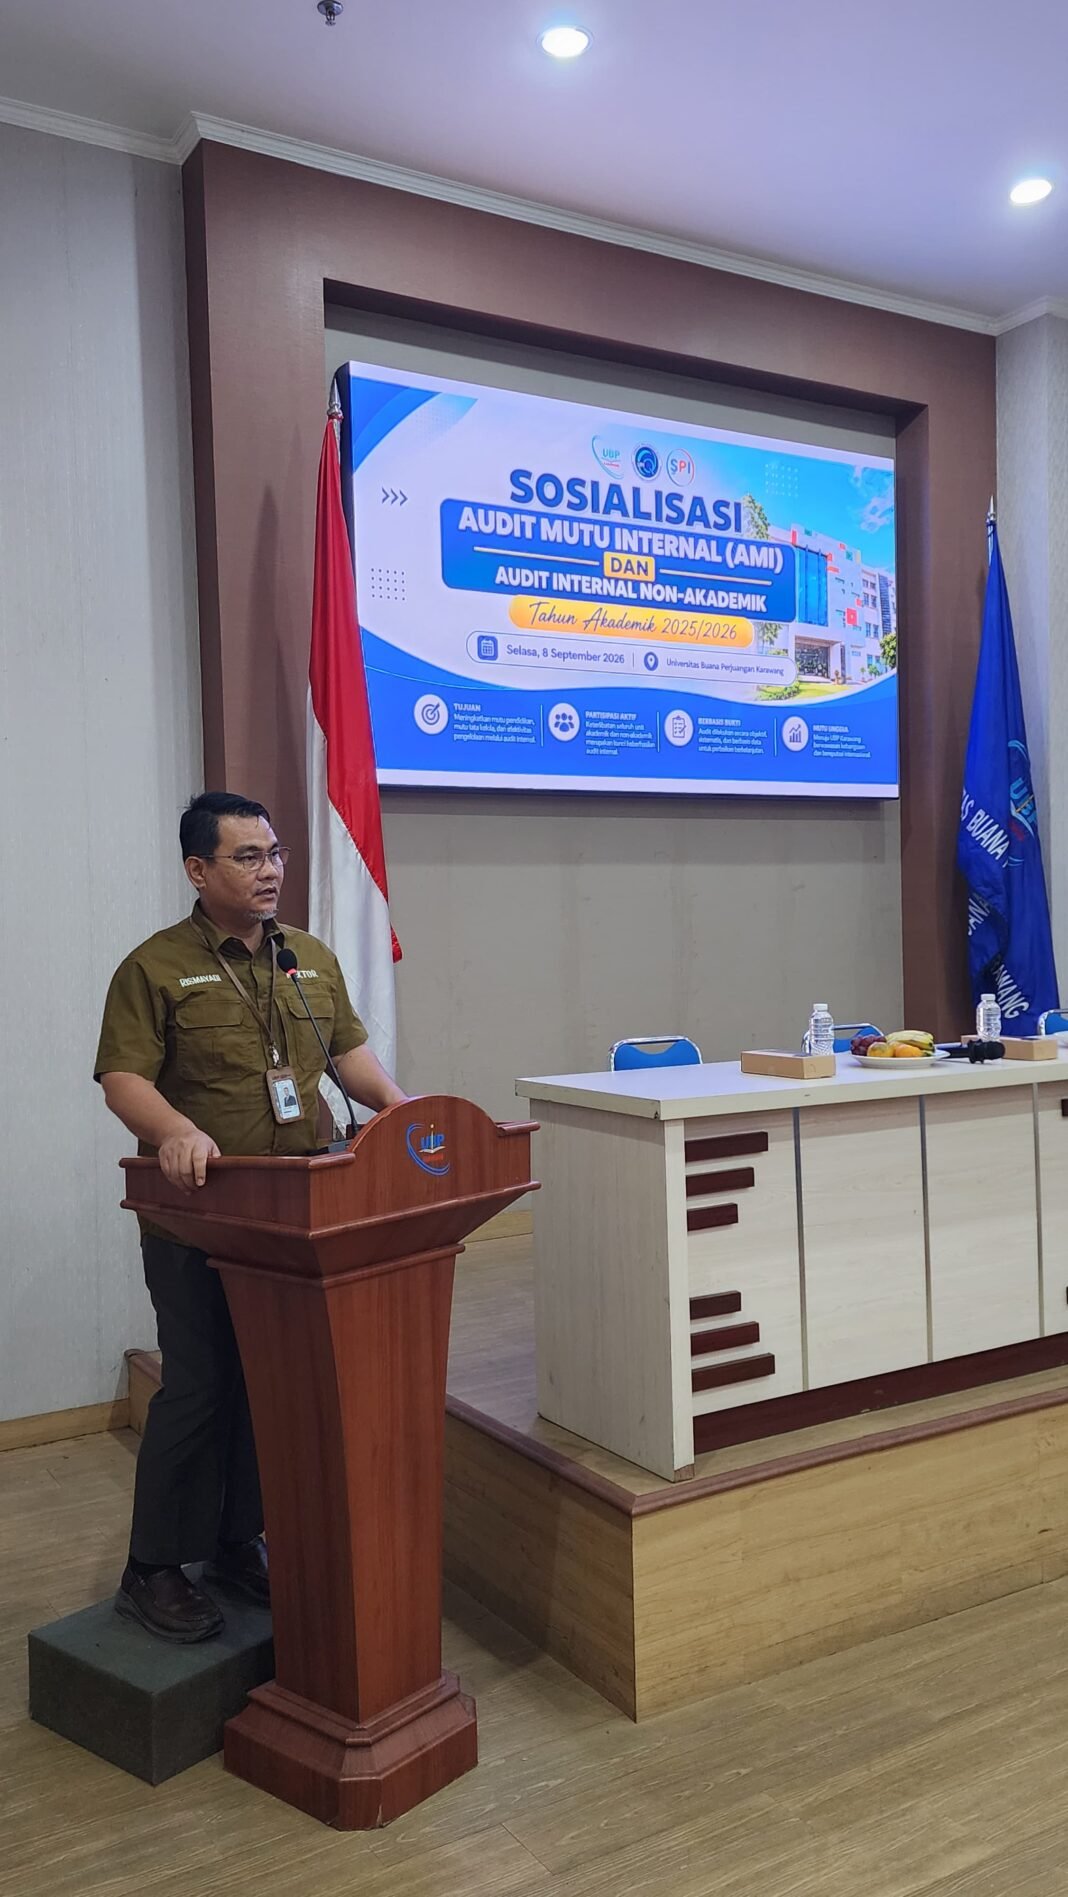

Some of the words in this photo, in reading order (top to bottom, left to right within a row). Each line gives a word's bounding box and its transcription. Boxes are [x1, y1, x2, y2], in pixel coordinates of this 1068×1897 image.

[670, 459, 691, 474] SPI
[510, 469, 742, 533] SOSIALISASI
[458, 507, 537, 539] AUDIT
[540, 518, 611, 549] MUTU
[614, 528, 722, 563] INTERNAL
[726, 542, 784, 574] (AMI)
[610, 557, 649, 576] DAN
[495, 566, 550, 589] AUDIT
[552, 572, 638, 599] INTERNAL
[640, 584, 767, 612] NON-AKADEMIK
[529, 602, 578, 626] Tahun
[582, 607, 658, 633] Akademik
[661, 618, 737, 640] 2025/2026
[506, 644, 540, 658] Selasa,
[542, 648, 549, 657] 8
[551, 648, 602, 662] September
[603, 652, 625, 664] 2026
[666, 657, 700, 669] Universitas
[701, 660, 720, 670] Buana
[721, 663, 755, 674] Perjuangan
[756, 666, 784, 676] Karawang
[453, 703, 481, 712] TUJUAN
[966, 808, 1010, 860] BUANA
[179, 974, 222, 988] RISMAYADI
